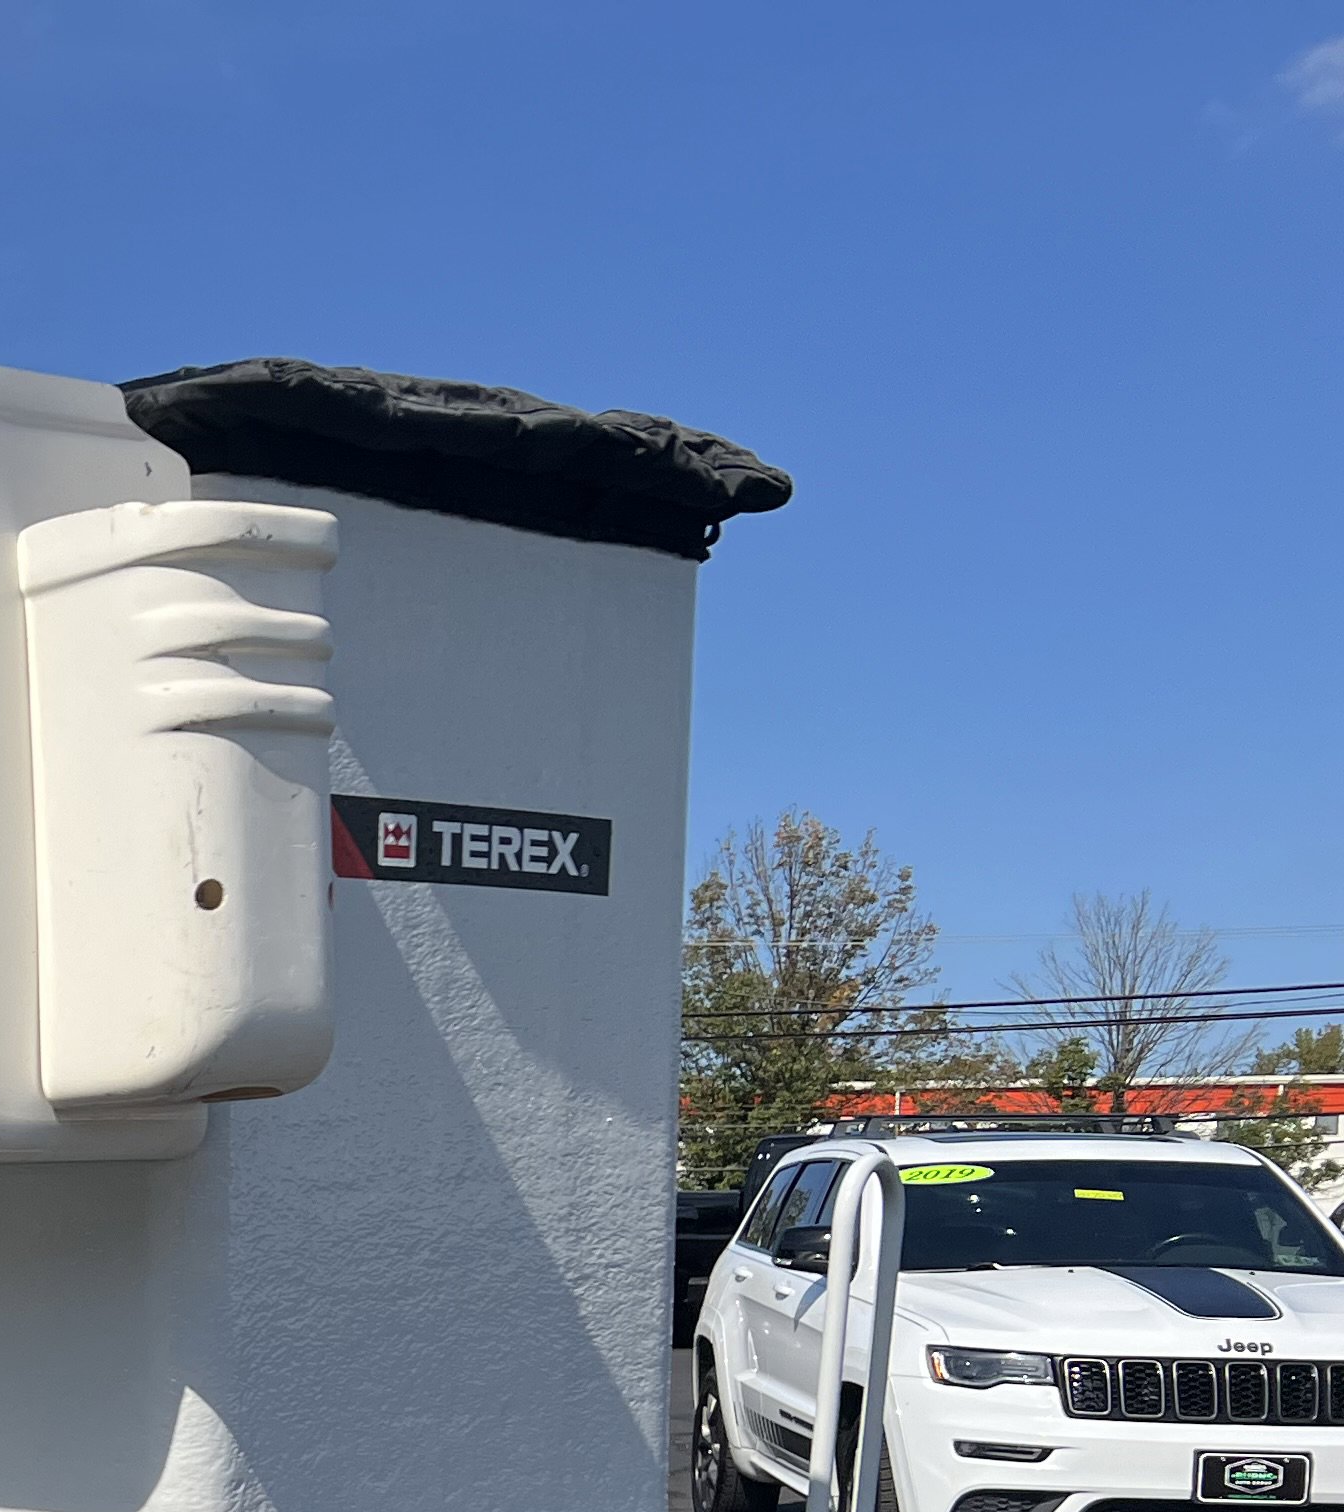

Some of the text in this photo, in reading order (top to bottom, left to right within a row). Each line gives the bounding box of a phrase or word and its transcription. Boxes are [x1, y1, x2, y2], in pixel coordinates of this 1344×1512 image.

[431, 820, 580, 877] TEREX
[905, 1168, 976, 1182] 2019
[1217, 1338, 1274, 1356] Jeep
